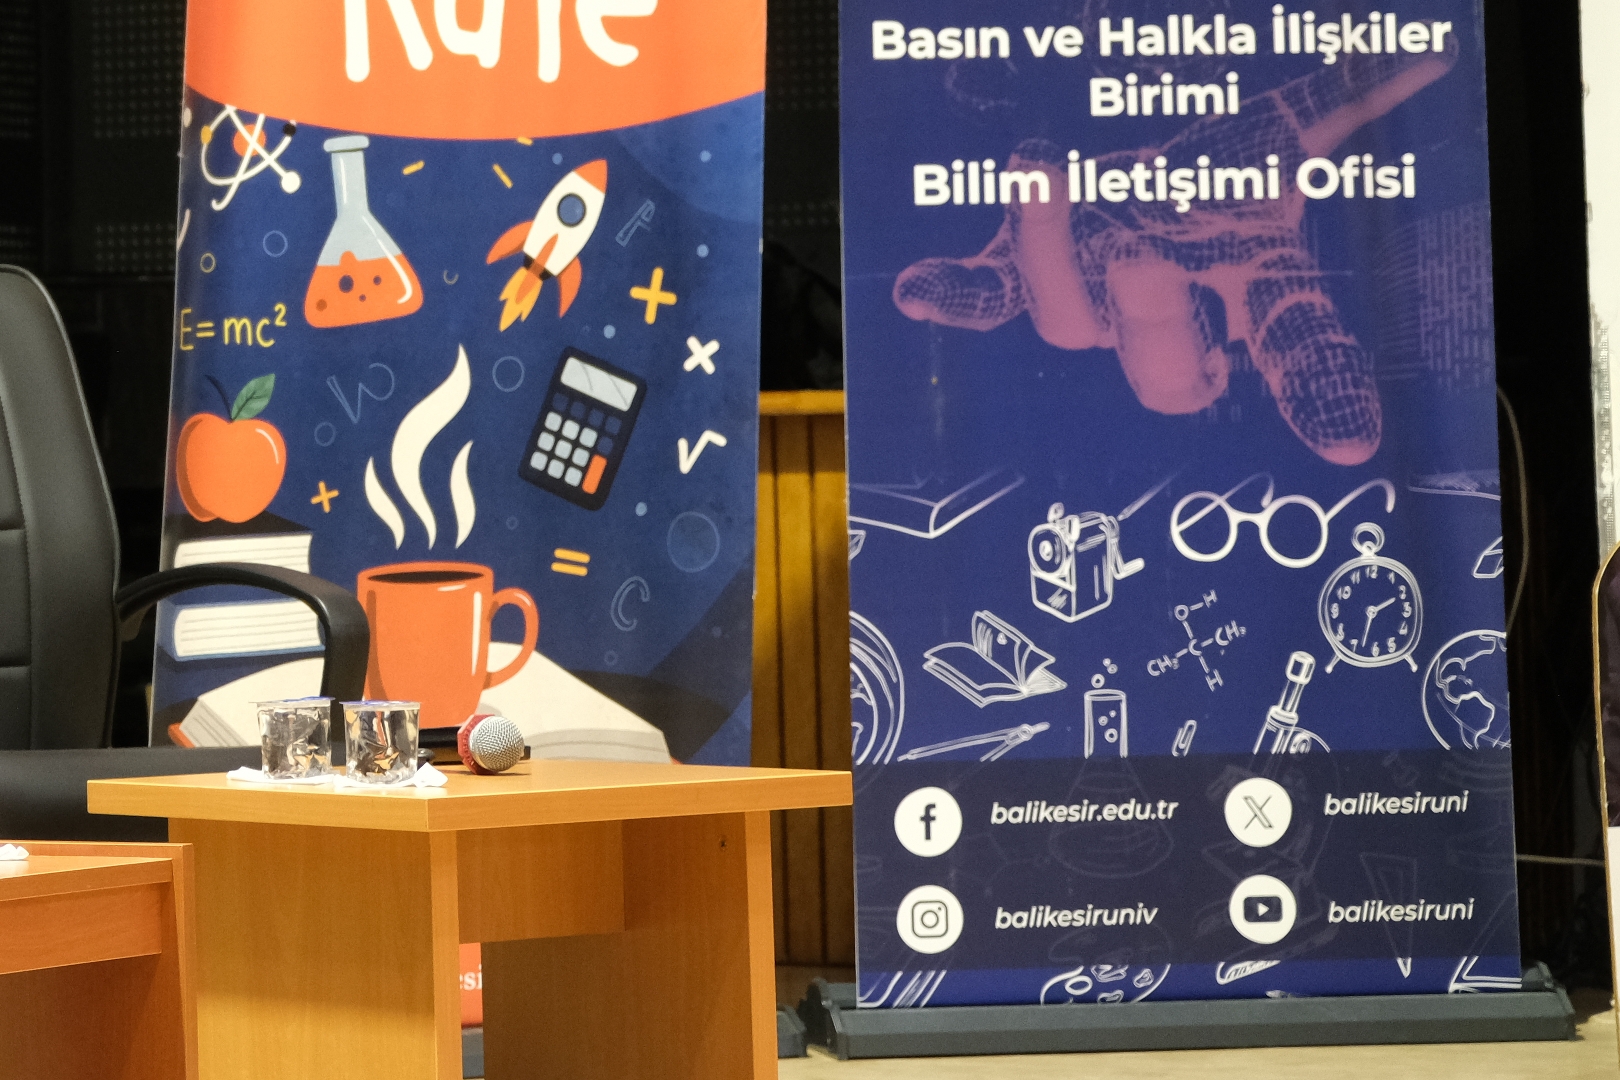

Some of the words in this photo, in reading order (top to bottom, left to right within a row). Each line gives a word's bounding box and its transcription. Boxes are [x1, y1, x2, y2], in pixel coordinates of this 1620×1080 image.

[872, 20, 1010, 60] Basın
[1023, 25, 1084, 58] ve
[1098, 13, 1256, 57] Halkla
[1272, 3, 1452, 65] İlişkiler
[1089, 71, 1240, 117] Birimi
[913, 158, 1051, 206] Bilim
[1067, 149, 1280, 214] İletişimi
[1295, 152, 1416, 200] Ofisi
[990, 797, 1180, 825] balikesir.edu.tr
[1323, 789, 1470, 816] balikesiruni
[994, 902, 1159, 930] balikesiruniv
[1327, 897, 1475, 924] balikesiruni
